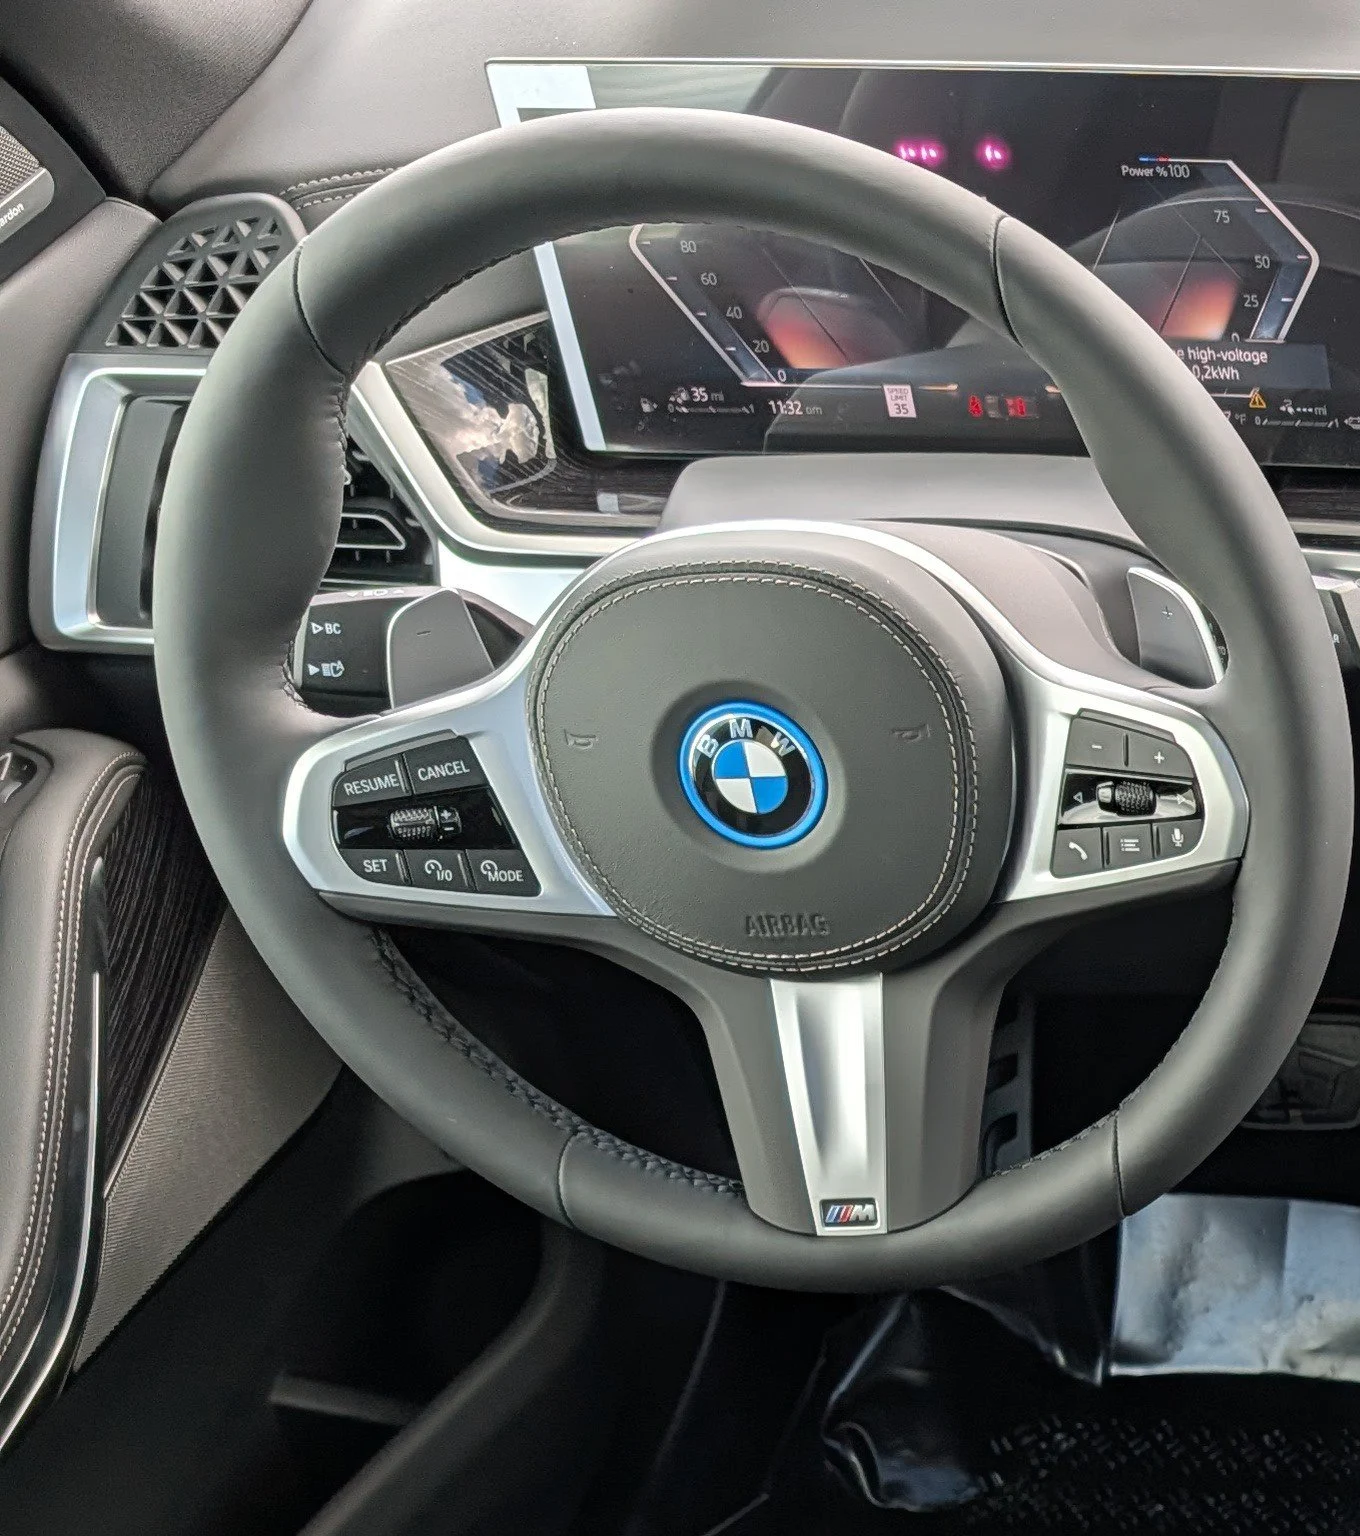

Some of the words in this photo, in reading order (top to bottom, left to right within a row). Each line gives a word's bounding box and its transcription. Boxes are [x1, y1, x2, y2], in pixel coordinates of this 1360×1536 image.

[1120, 164, 1154, 177] Power
[1214, 210, 1230, 224] 75
[680, 240, 697, 254] 80
[1254, 255, 1271, 269] 50
[700, 273, 718, 286] 60
[1243, 295, 1259, 308] 25
[725, 306, 743, 320] 40
[752, 340, 770, 354] 20
[1188, 346, 1268, 365] high-voltage
[777, 369, 787, 383] 0
[690, 387, 709, 402] 35
[769, 400, 804, 415] 11:32
[894, 403, 909, 415] 35
[324, 623, 342, 635] BC
[697, 718, 797, 759] BMW
[417, 760, 470, 781] CANCEL
[344, 774, 399, 796] RESUME
[363, 859, 388, 873] SET
[487, 870, 524, 882] MODE
[745, 913, 831, 937] AIRBAG
